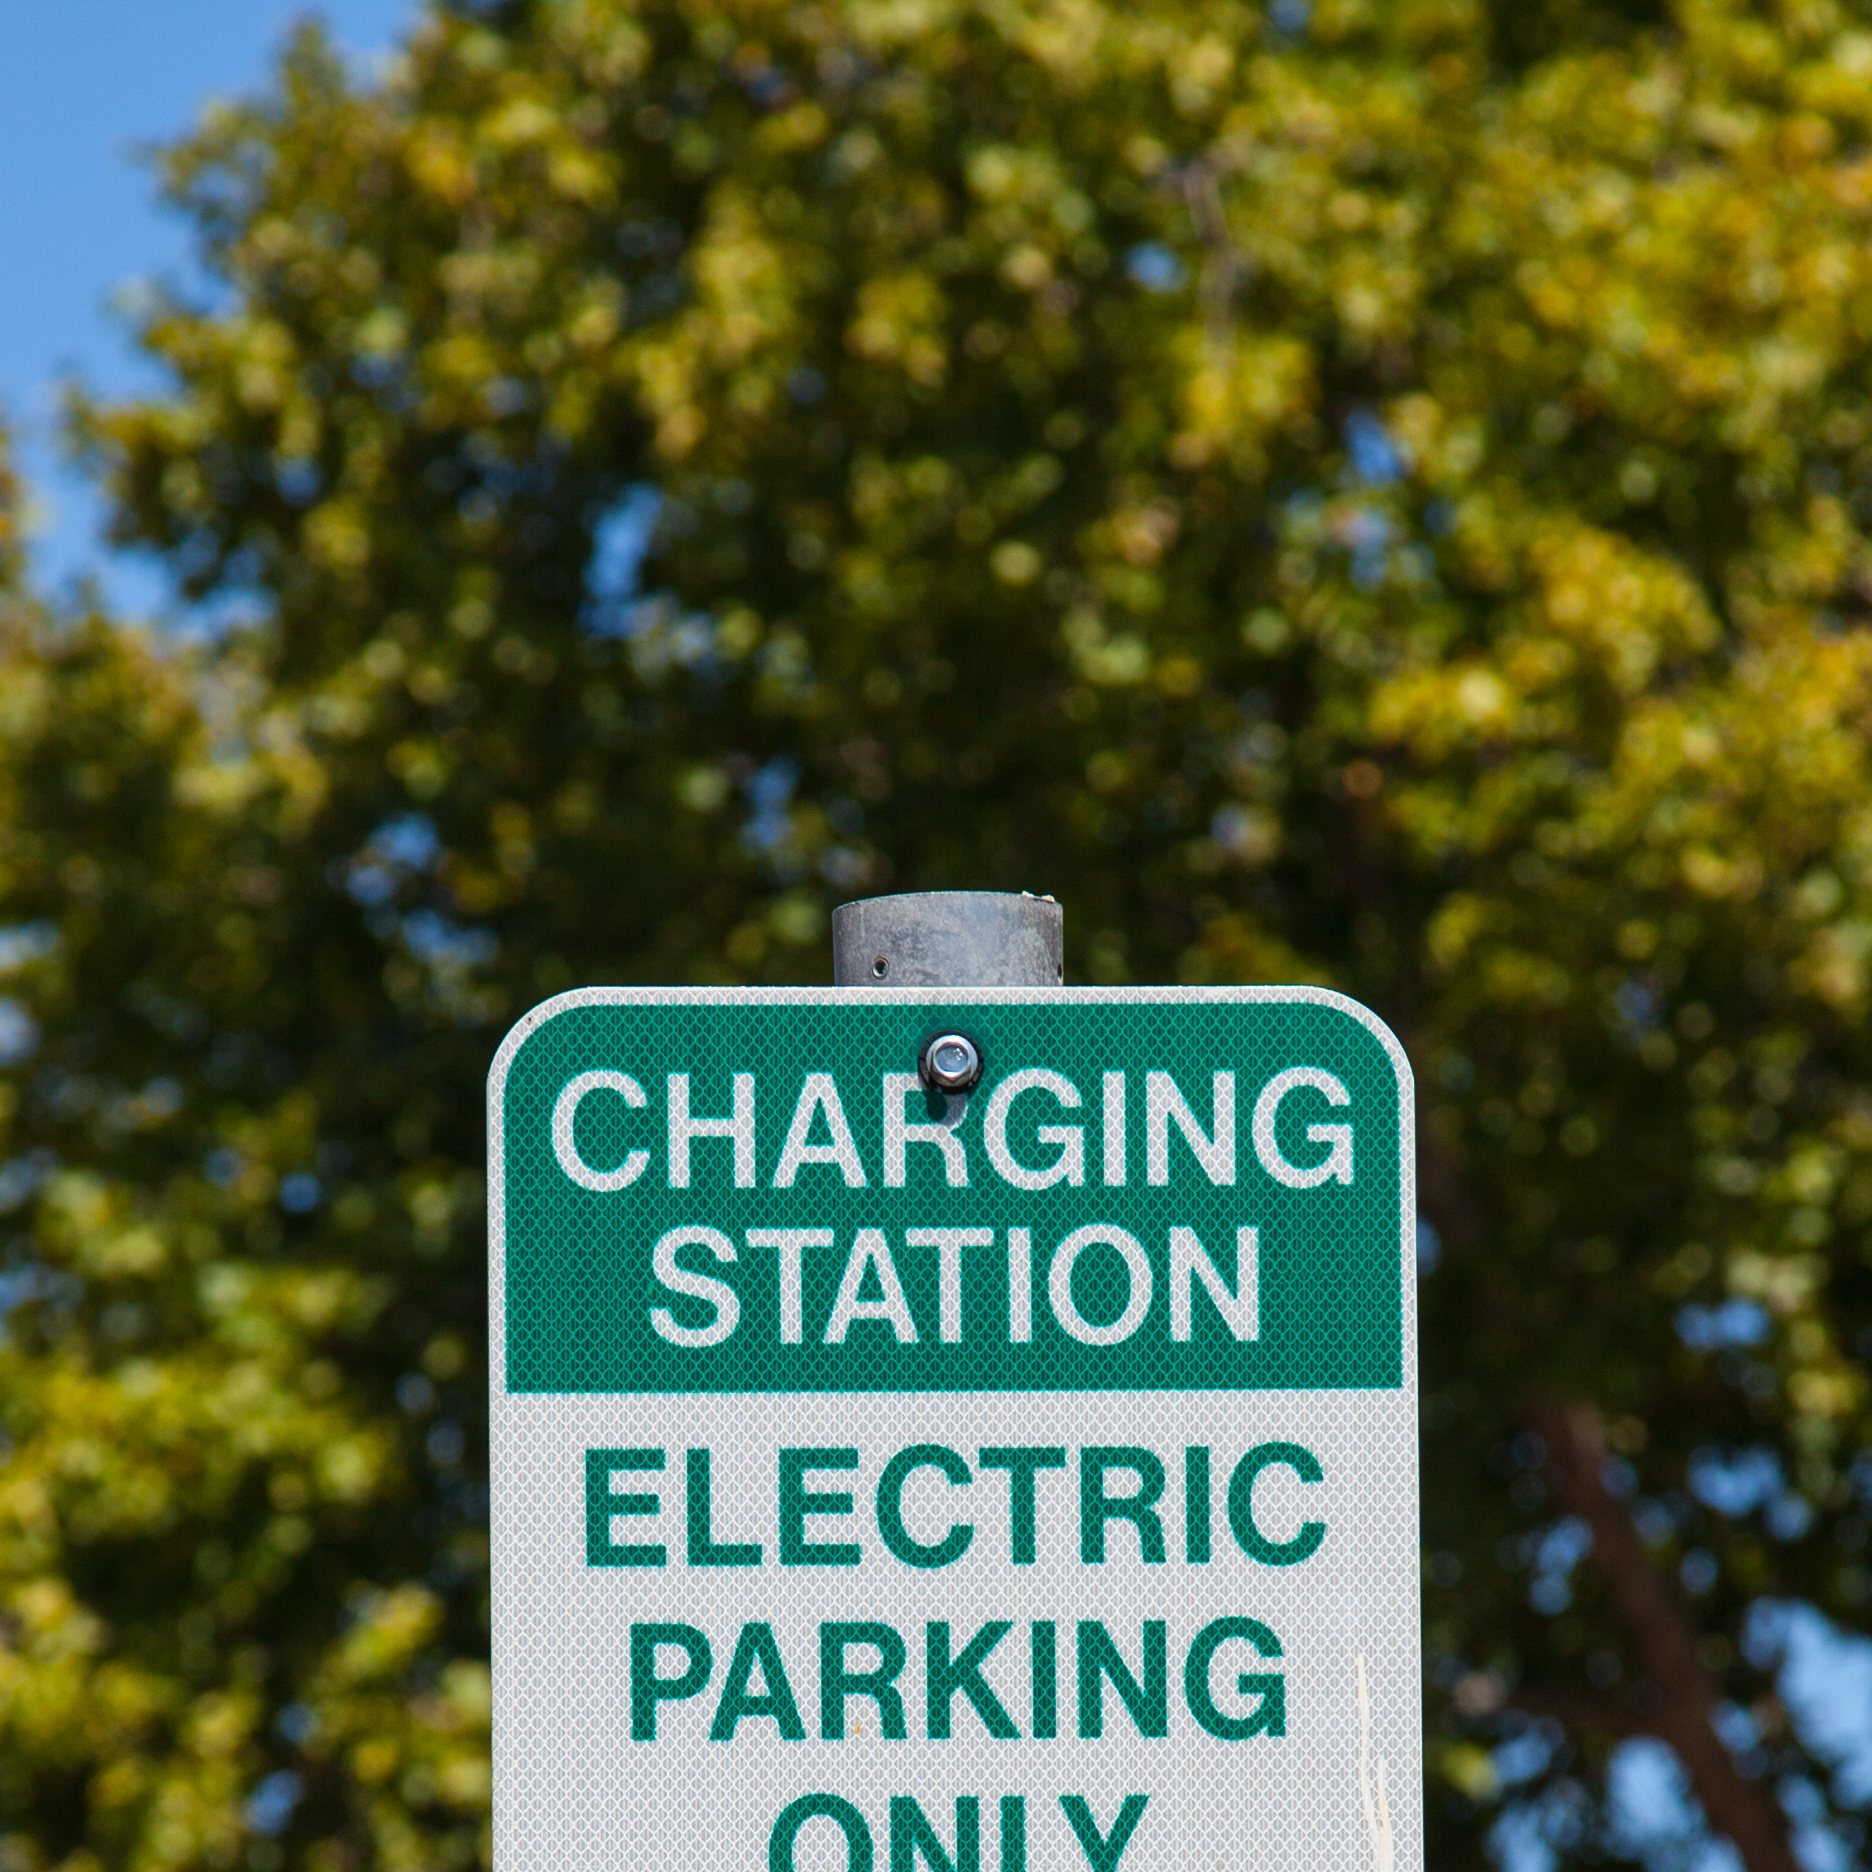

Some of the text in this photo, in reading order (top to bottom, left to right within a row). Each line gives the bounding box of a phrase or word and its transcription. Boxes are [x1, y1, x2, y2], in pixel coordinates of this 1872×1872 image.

[551, 1066, 1354, 1191] CHARGING
[651, 1224, 1260, 1347] STATION
[585, 1442, 1326, 1569] ELECTRIC
[629, 1616, 1287, 1741] PARKING
